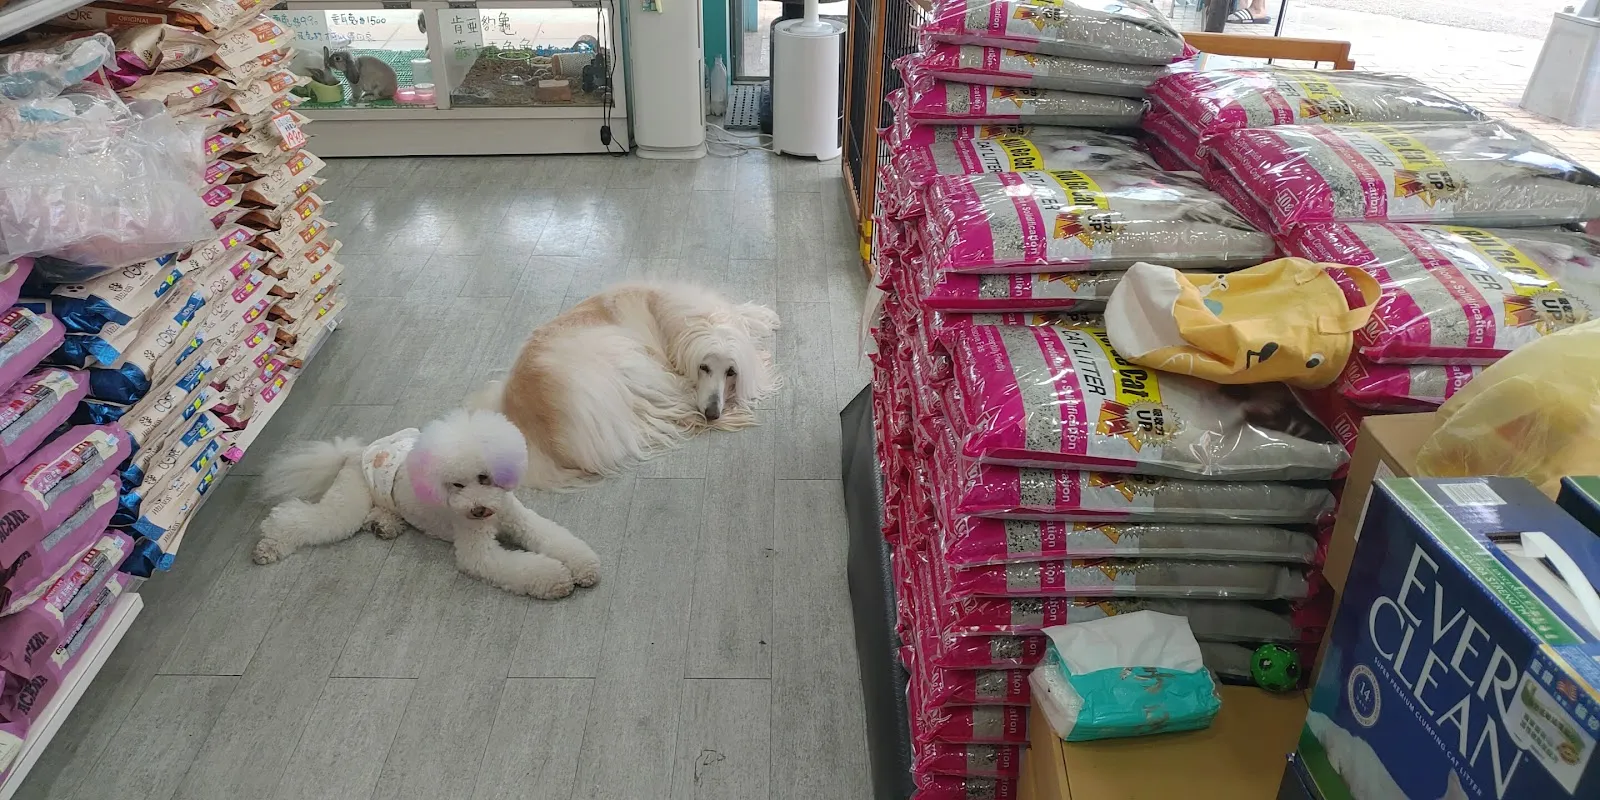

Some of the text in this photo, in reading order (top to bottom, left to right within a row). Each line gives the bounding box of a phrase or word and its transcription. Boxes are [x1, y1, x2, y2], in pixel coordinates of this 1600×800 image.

[976, 141, 994, 151] CAT
[1426, 171, 1444, 190] UP
[1542, 299, 1563, 321] UP
[1062, 330, 1088, 348] CAT
[1073, 348, 1106, 396] LITTER
[1119, 369, 1149, 398] Cat
[1136, 410, 1153, 432] UP
[1152, 408, 1164, 436] 吸收力
[1462, 553, 1529, 617] EXTRA STRENGTH
[1397, 544, 1526, 748] EVER
[1360, 681, 1371, 702] 14
[1369, 596, 1523, 800] CLEAN
[1374, 656, 1483, 797] SUPER PREMIUM CLUMPING CAT LITTER
